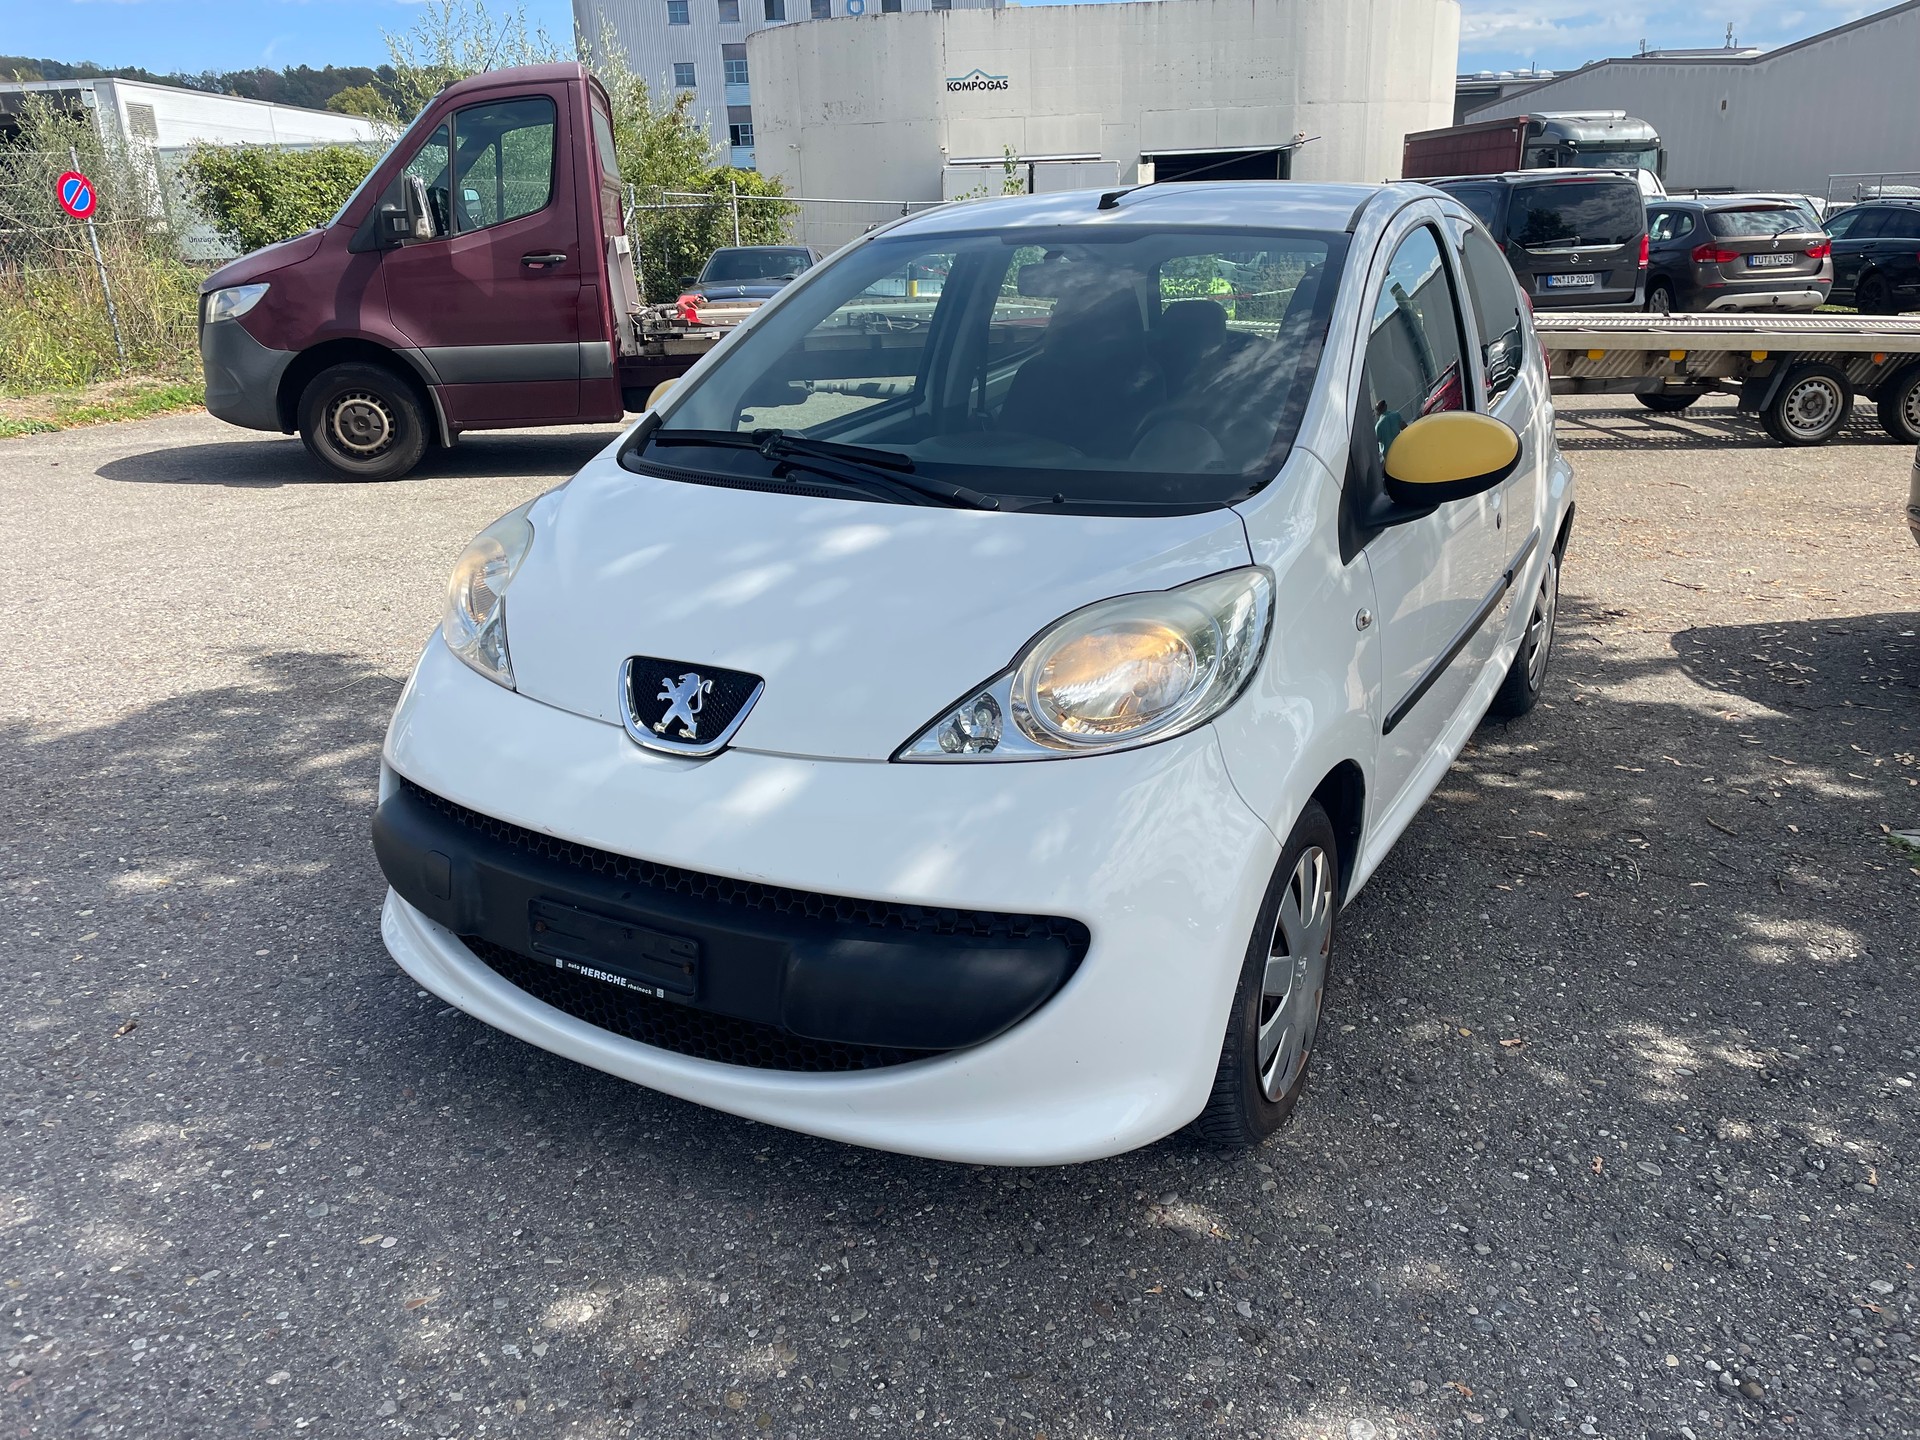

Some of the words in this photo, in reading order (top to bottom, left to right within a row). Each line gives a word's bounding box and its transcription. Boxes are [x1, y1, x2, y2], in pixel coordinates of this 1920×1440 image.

[947, 80, 1008, 91] KOMPOGAS
[1754, 255, 1769, 264] TUT
[1773, 255, 1783, 263] YC
[1784, 254, 1793, 263] 55
[1577, 274, 1594, 284] 2010
[567, 962, 580, 970] auto
[580, 965, 627, 987] HERSCHE
